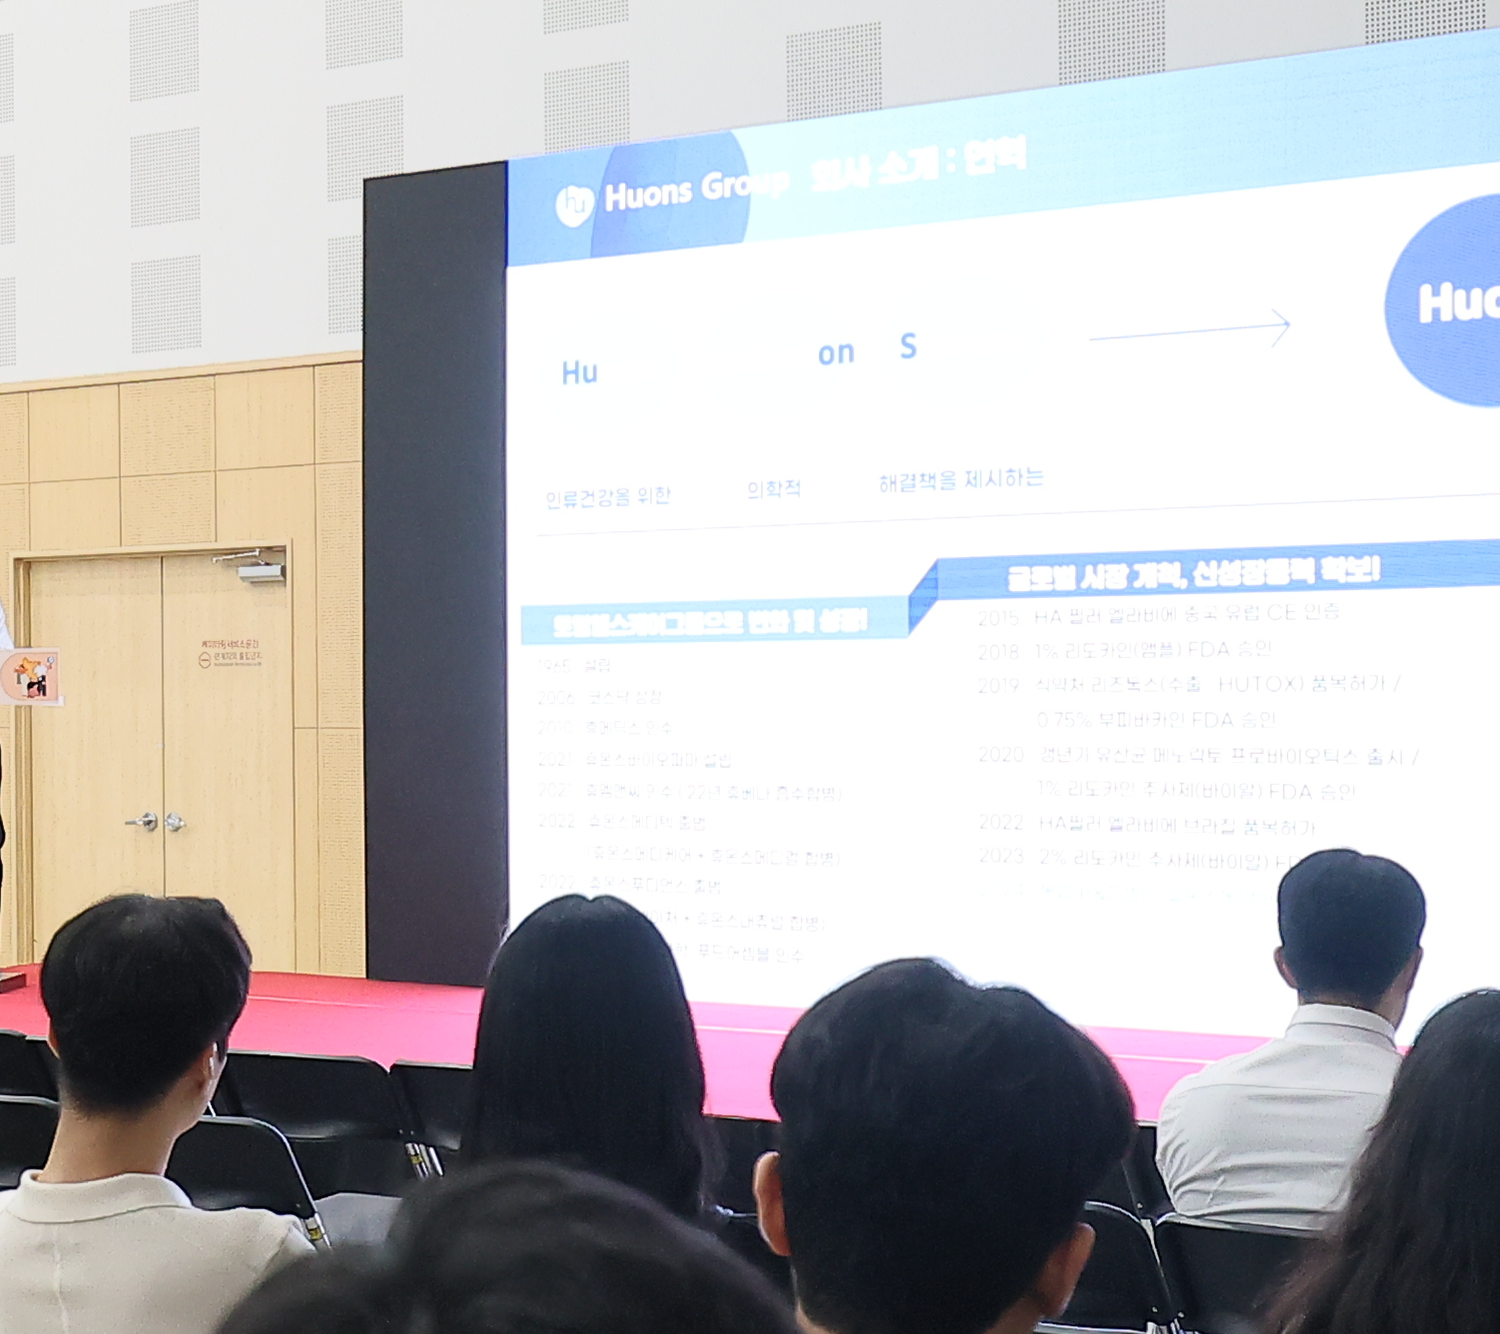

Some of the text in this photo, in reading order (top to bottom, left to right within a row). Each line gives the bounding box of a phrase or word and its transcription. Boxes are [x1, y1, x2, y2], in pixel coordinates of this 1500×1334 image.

[604, 179, 693, 212] Huons
[545, 479, 801, 510] 인류건강을 위한 의학적
[879, 468, 1046, 496] 해결책을 제시하는
